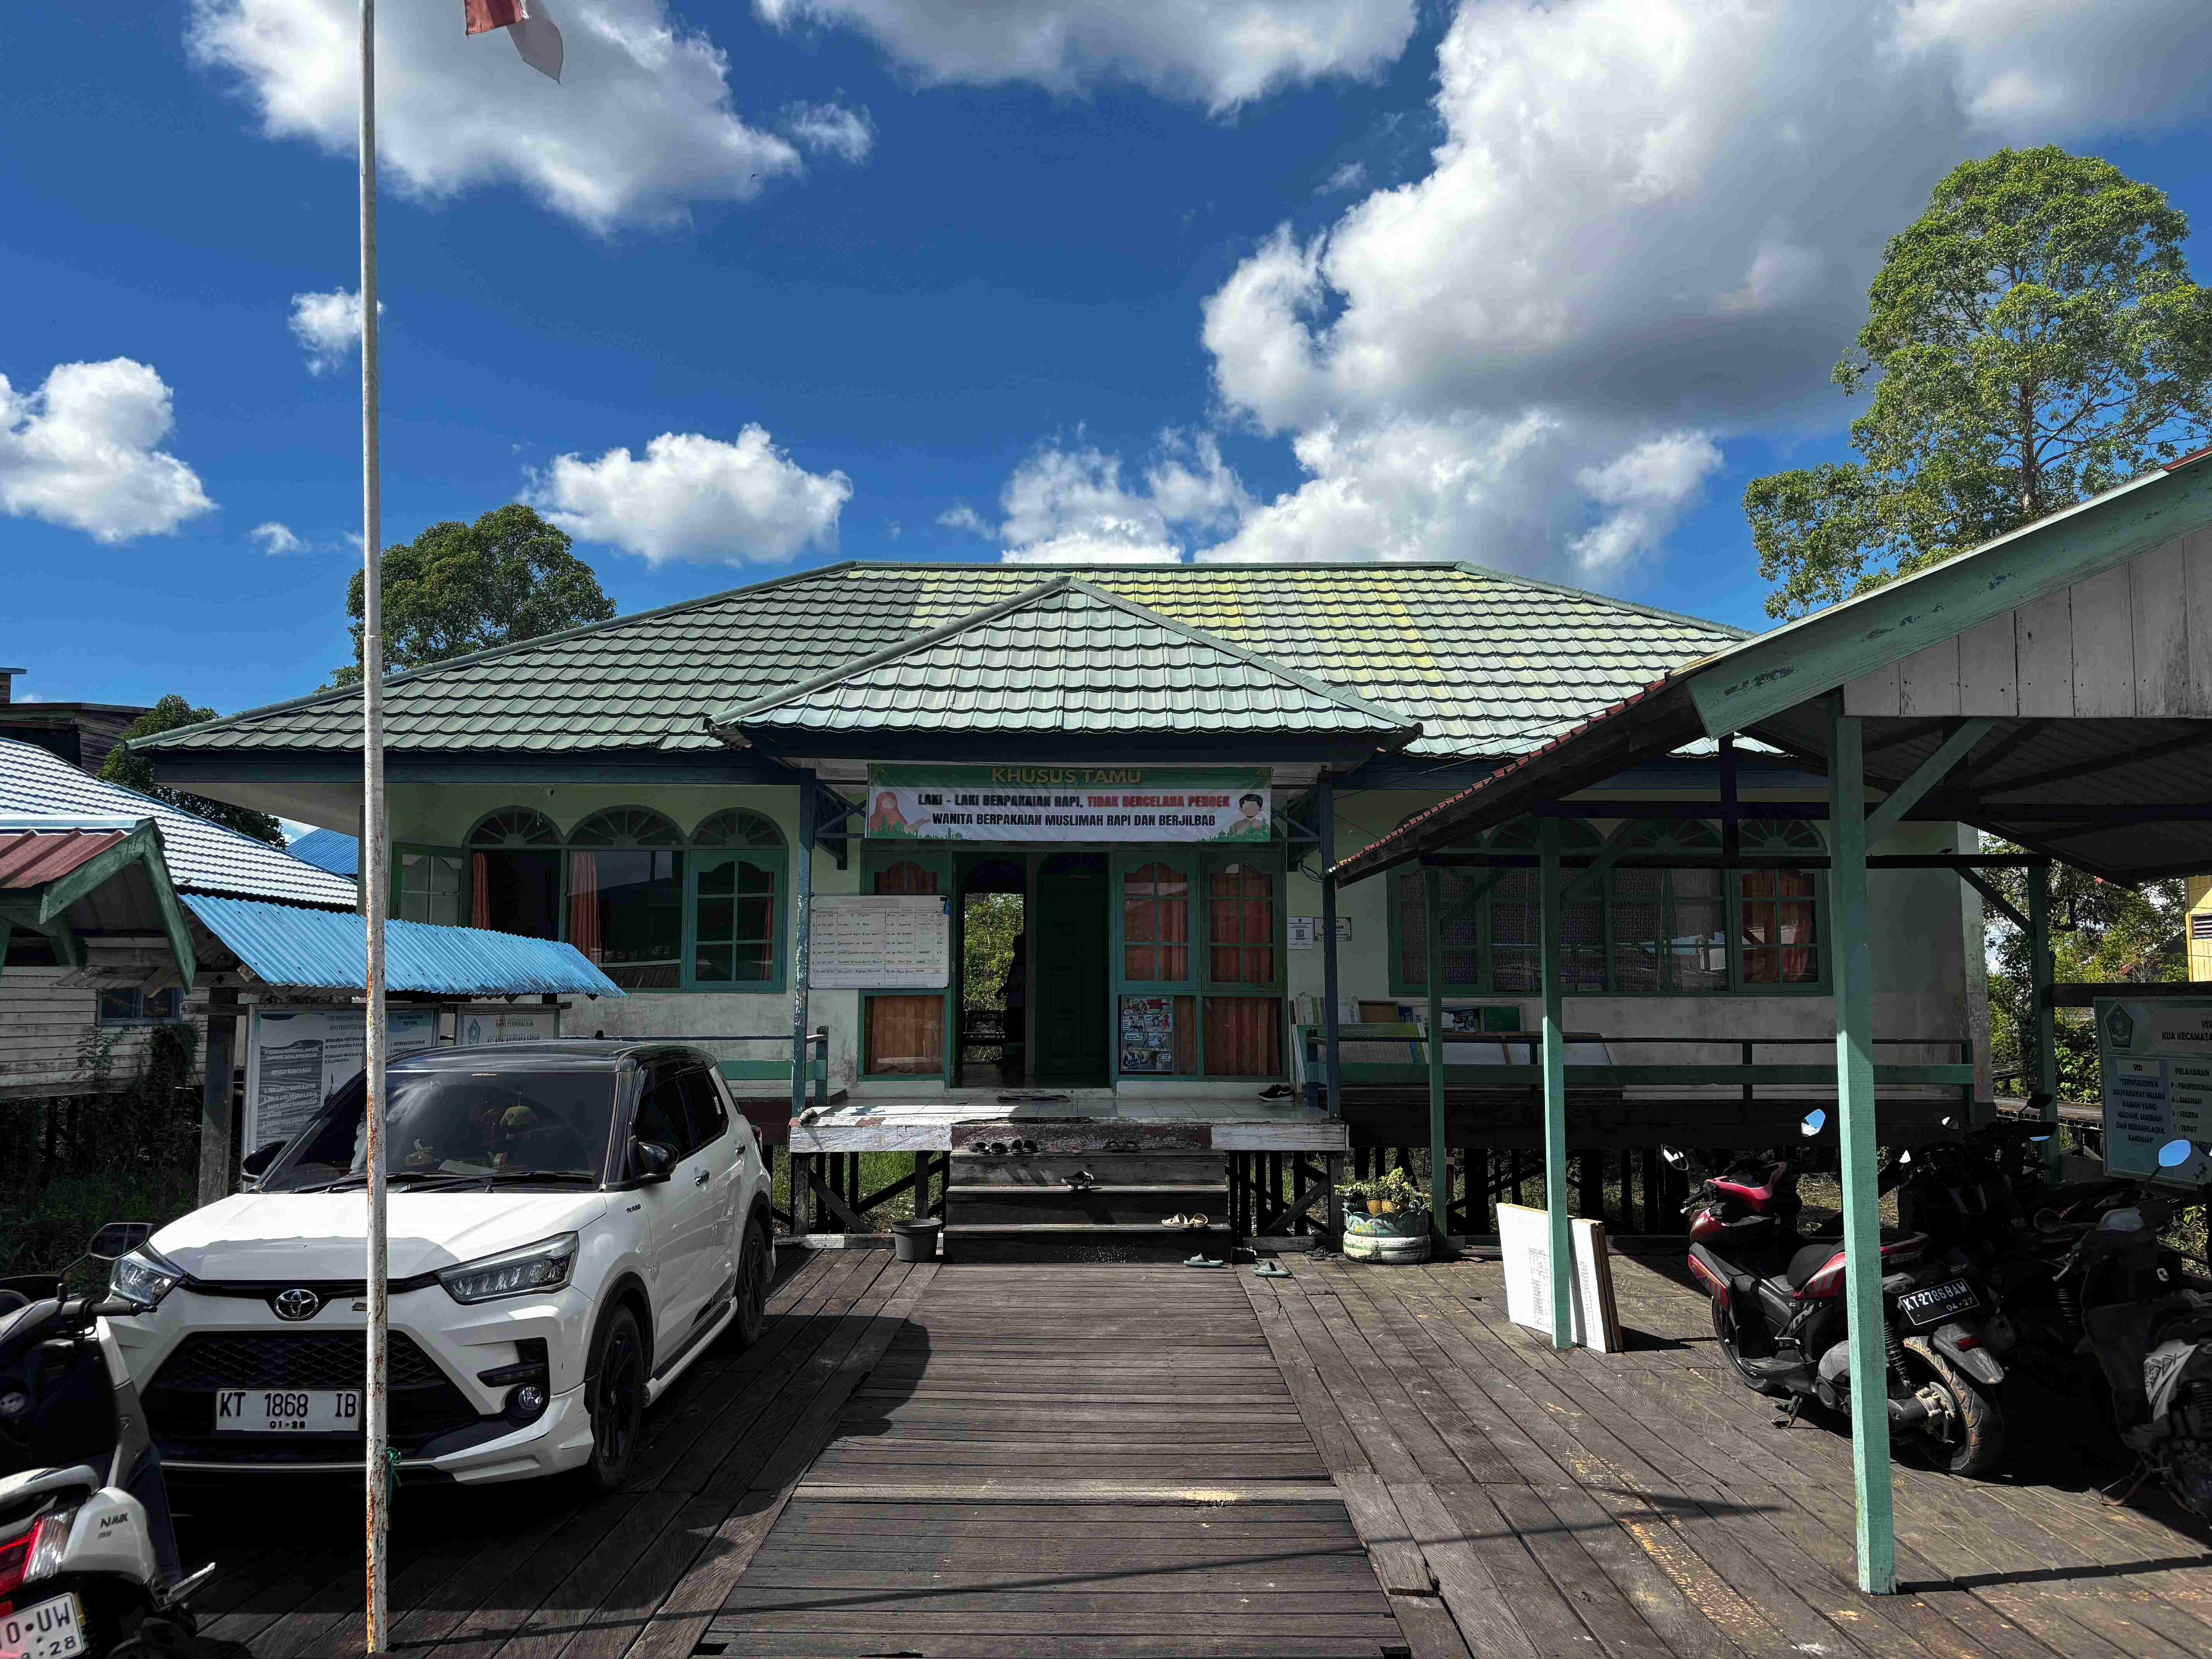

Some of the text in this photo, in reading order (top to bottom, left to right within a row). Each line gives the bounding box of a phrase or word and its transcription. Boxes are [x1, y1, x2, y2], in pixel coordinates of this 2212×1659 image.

[991, 768, 1142, 784] KHUSUS TAMU
[918, 794, 942, 805] LAKI
[955, 795, 979, 806] LAKI
[983, 795, 1050, 807] BERPAKAIAN
[1055, 795, 1083, 808] RAPI,
[1087, 796, 1118, 807] TIDAK
[1123, 796, 1183, 807] BERCELANA
[1188, 796, 1230, 807] PENDEK
[933, 813, 1215, 826] WANITA BERPAKAIAN MUSLIMAH RAPI DAN BERJILBAB
[2162, 1032, 2175, 1040] KUA
[2175, 1068, 2209, 1077] PELAYANAN
[2113, 1089, 2166, 1100] MASYARAKAT MUARA
[2179, 1097, 2202, 1105] AMANAH
[2181, 1125, 2197, 1133] TEPAT
[1903, 1282, 1967, 1310] KT 2786 BAW
[220, 1392, 357, 1417] KT 1868 IB
[37, 1602, 70, 1632] UW
